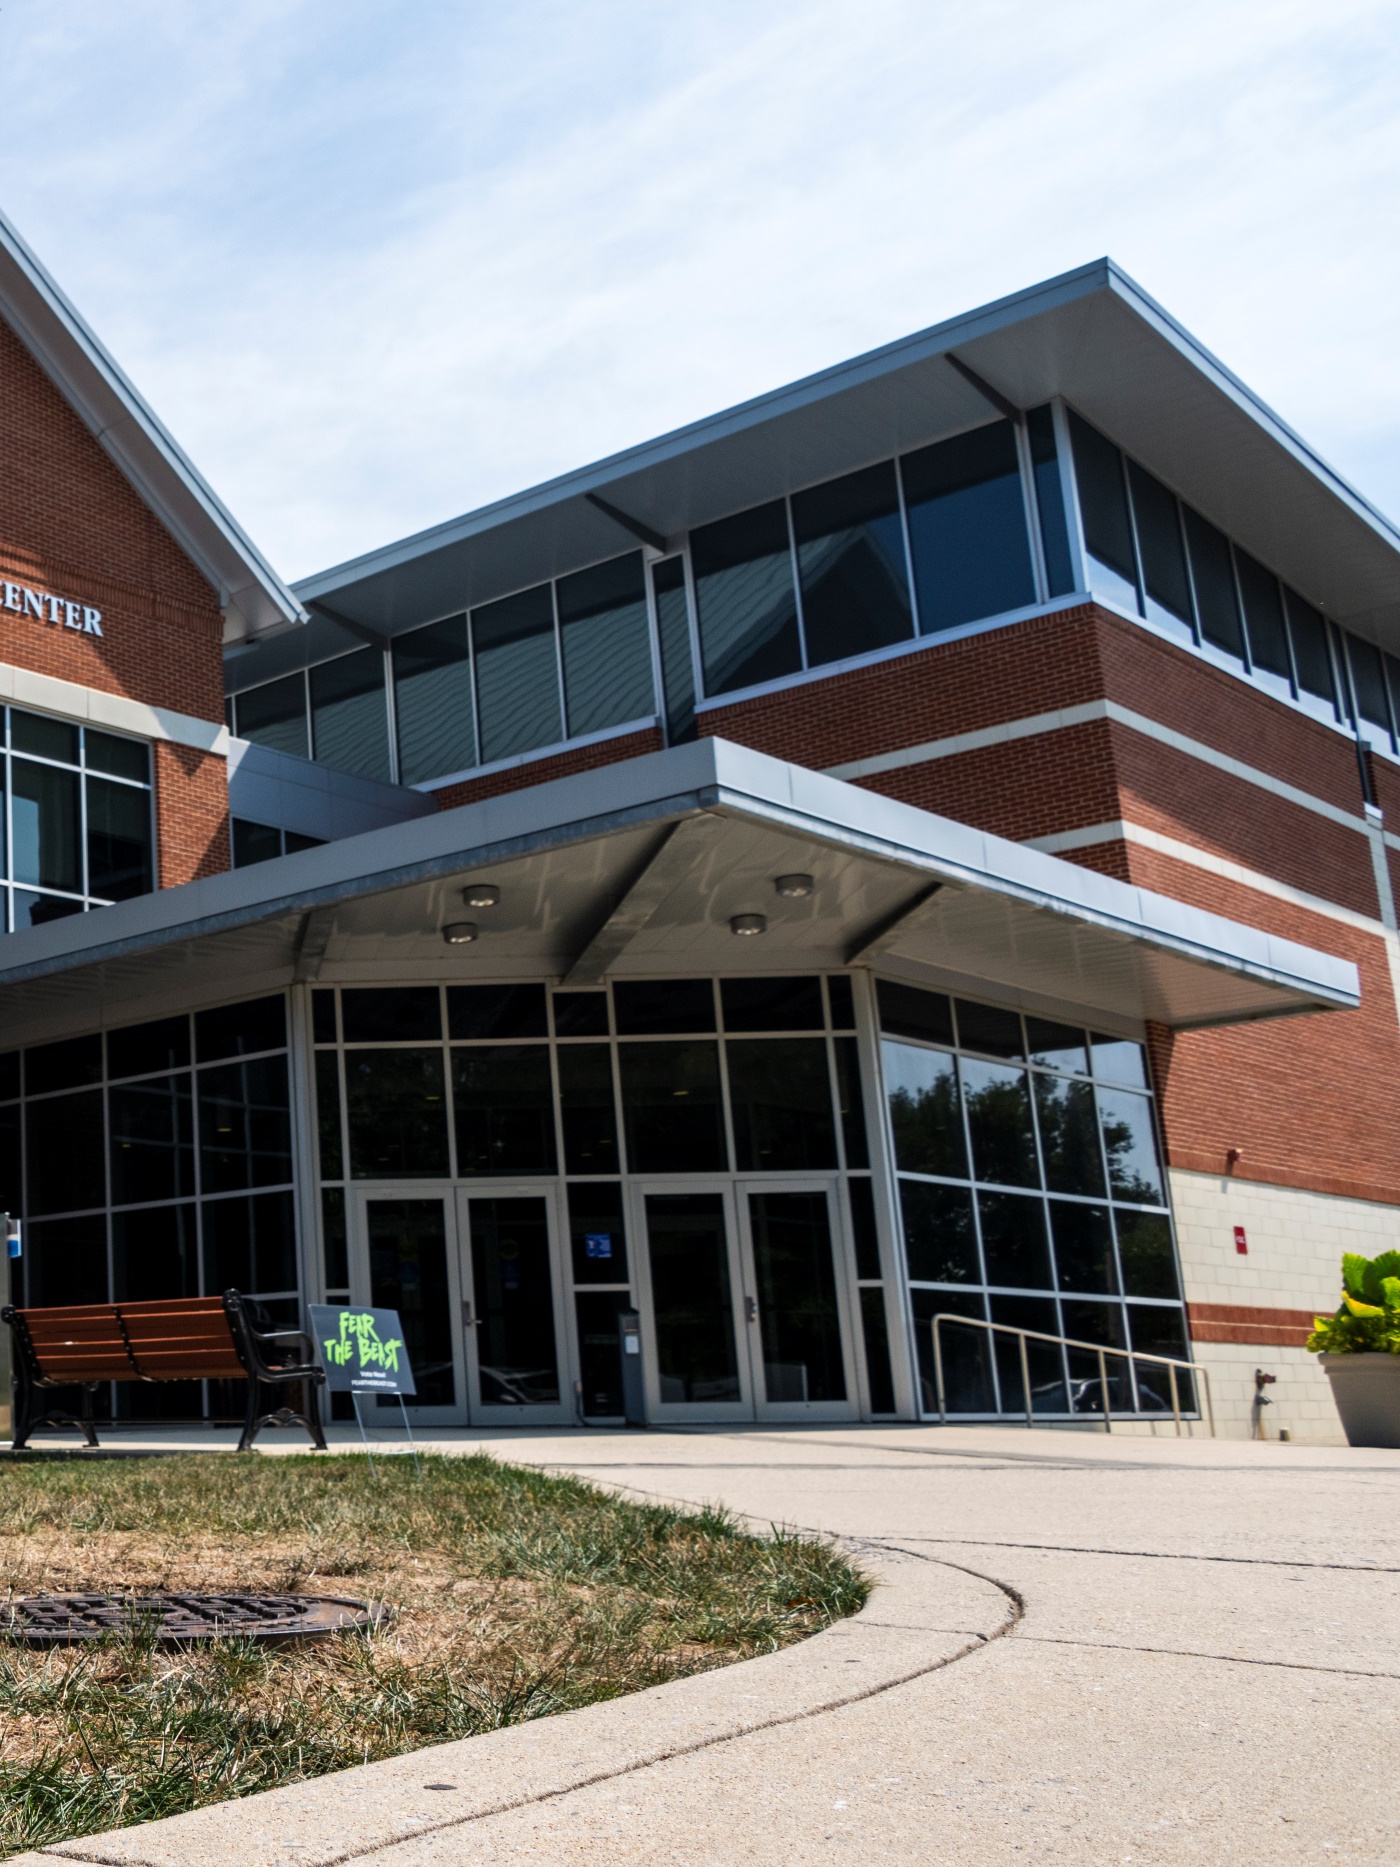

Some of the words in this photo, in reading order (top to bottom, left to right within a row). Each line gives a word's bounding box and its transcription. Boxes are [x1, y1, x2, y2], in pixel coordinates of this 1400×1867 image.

[339, 1311, 380, 1341] FEAR
[323, 1339, 354, 1366] THE
[358, 1336, 403, 1373] BEAST
